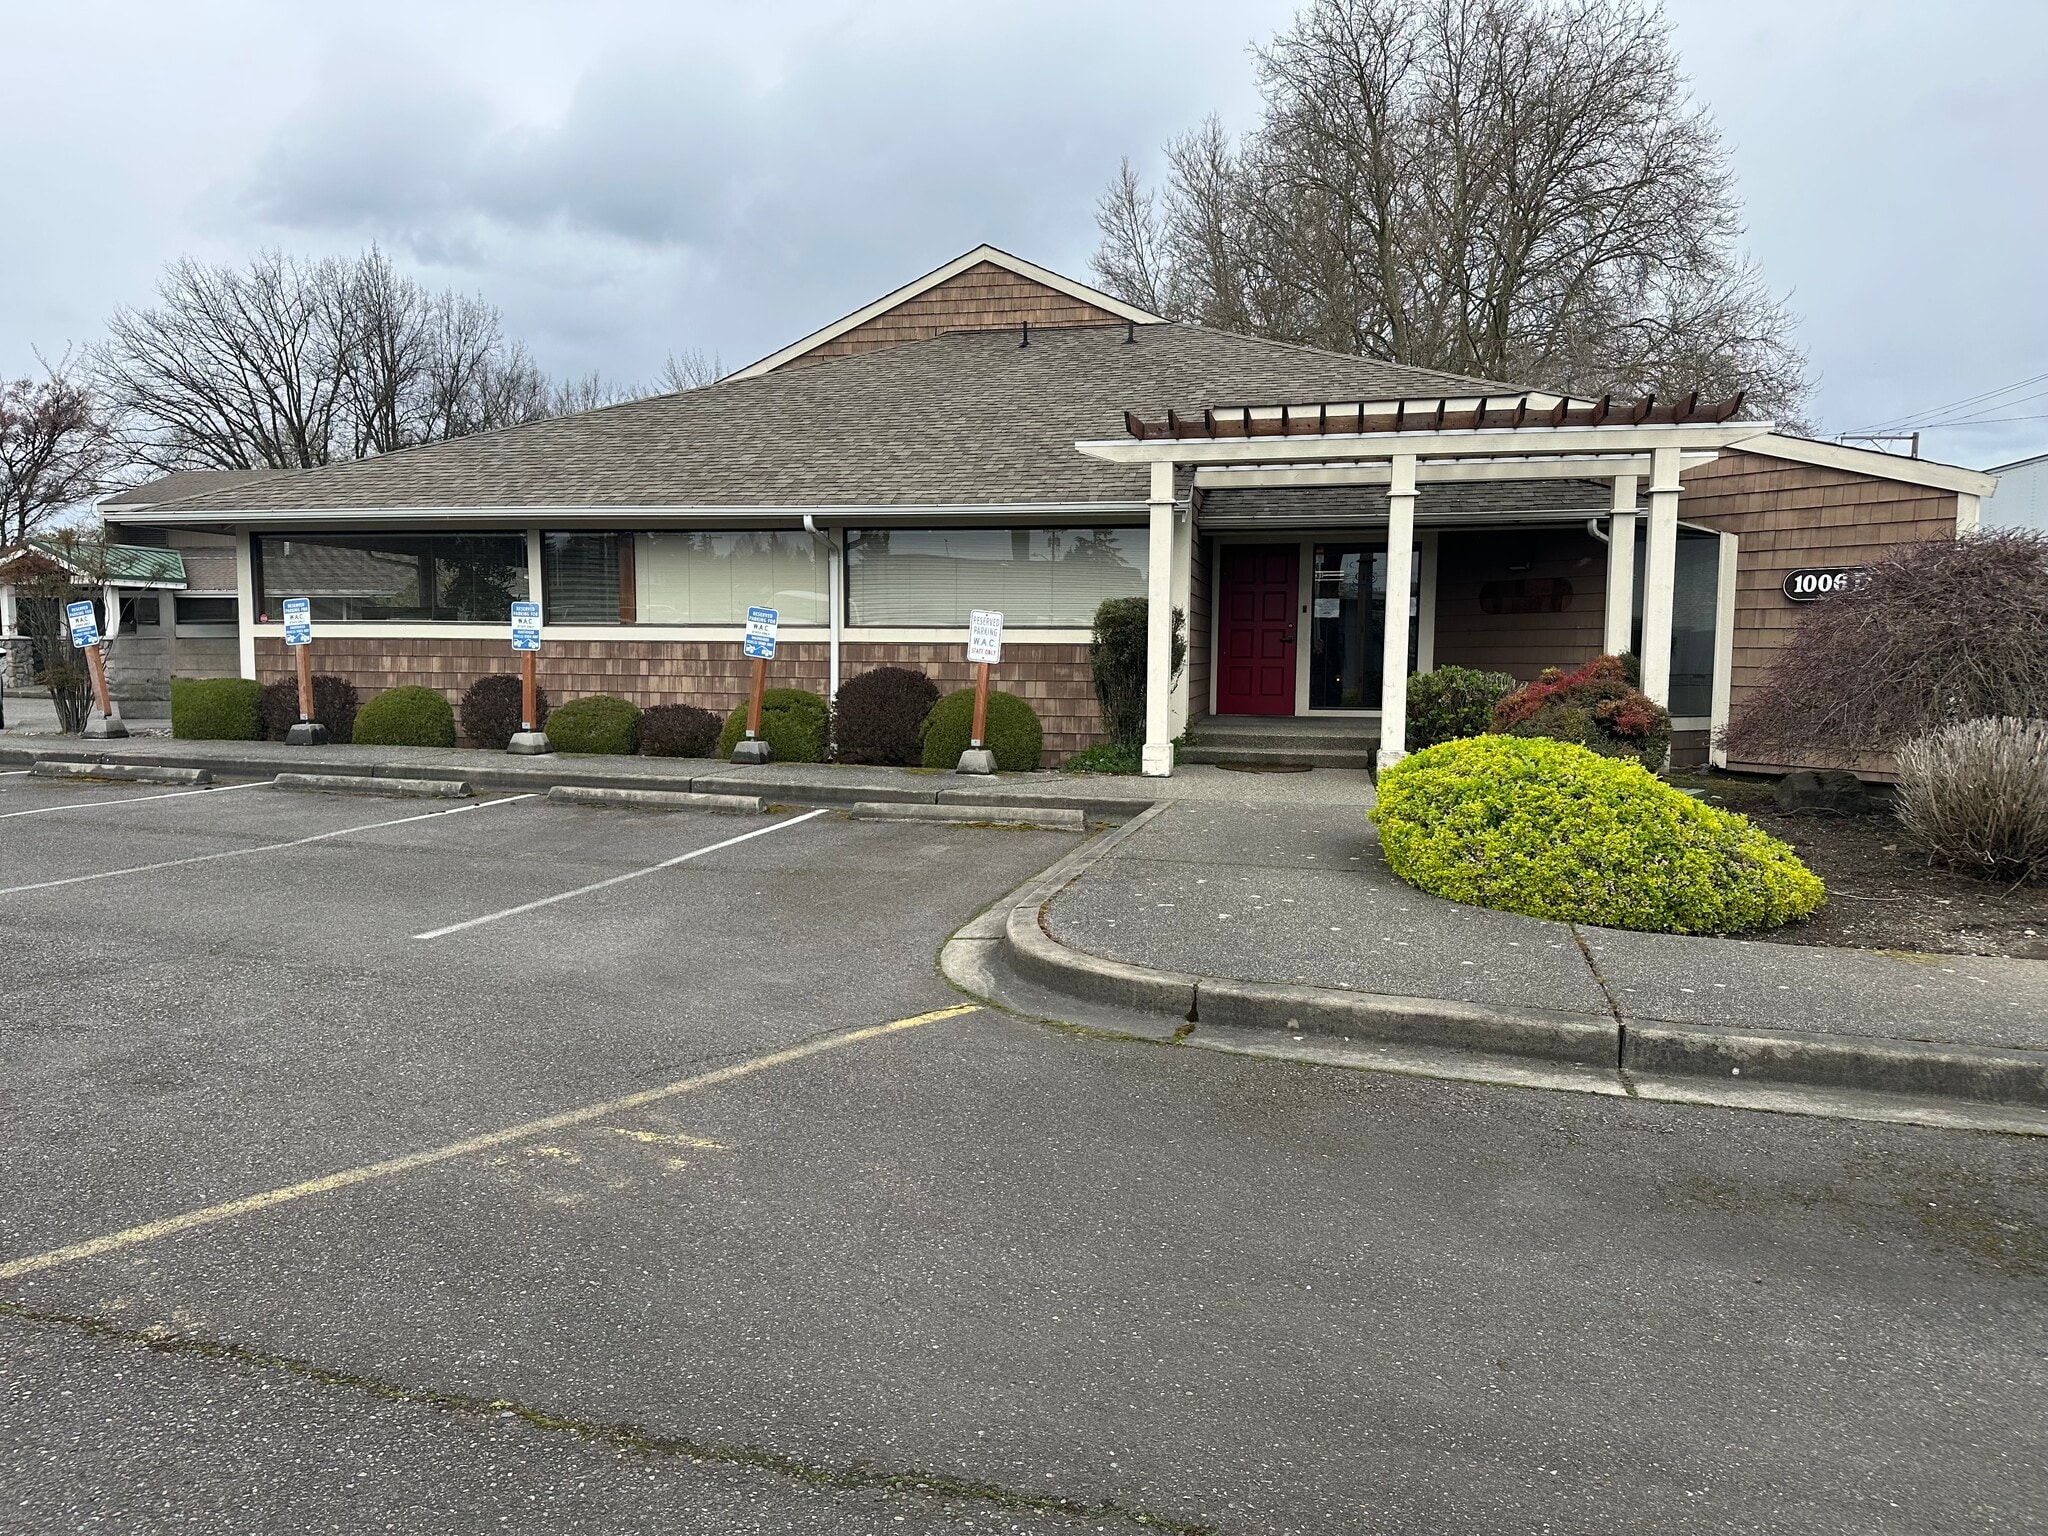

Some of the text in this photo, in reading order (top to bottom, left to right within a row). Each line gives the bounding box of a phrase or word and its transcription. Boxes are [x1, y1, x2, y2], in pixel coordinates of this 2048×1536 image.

[973, 616, 1000, 627] RESERVED
[973, 626, 998, 637] PARKING
[973, 637, 997, 647] W.A.C.
